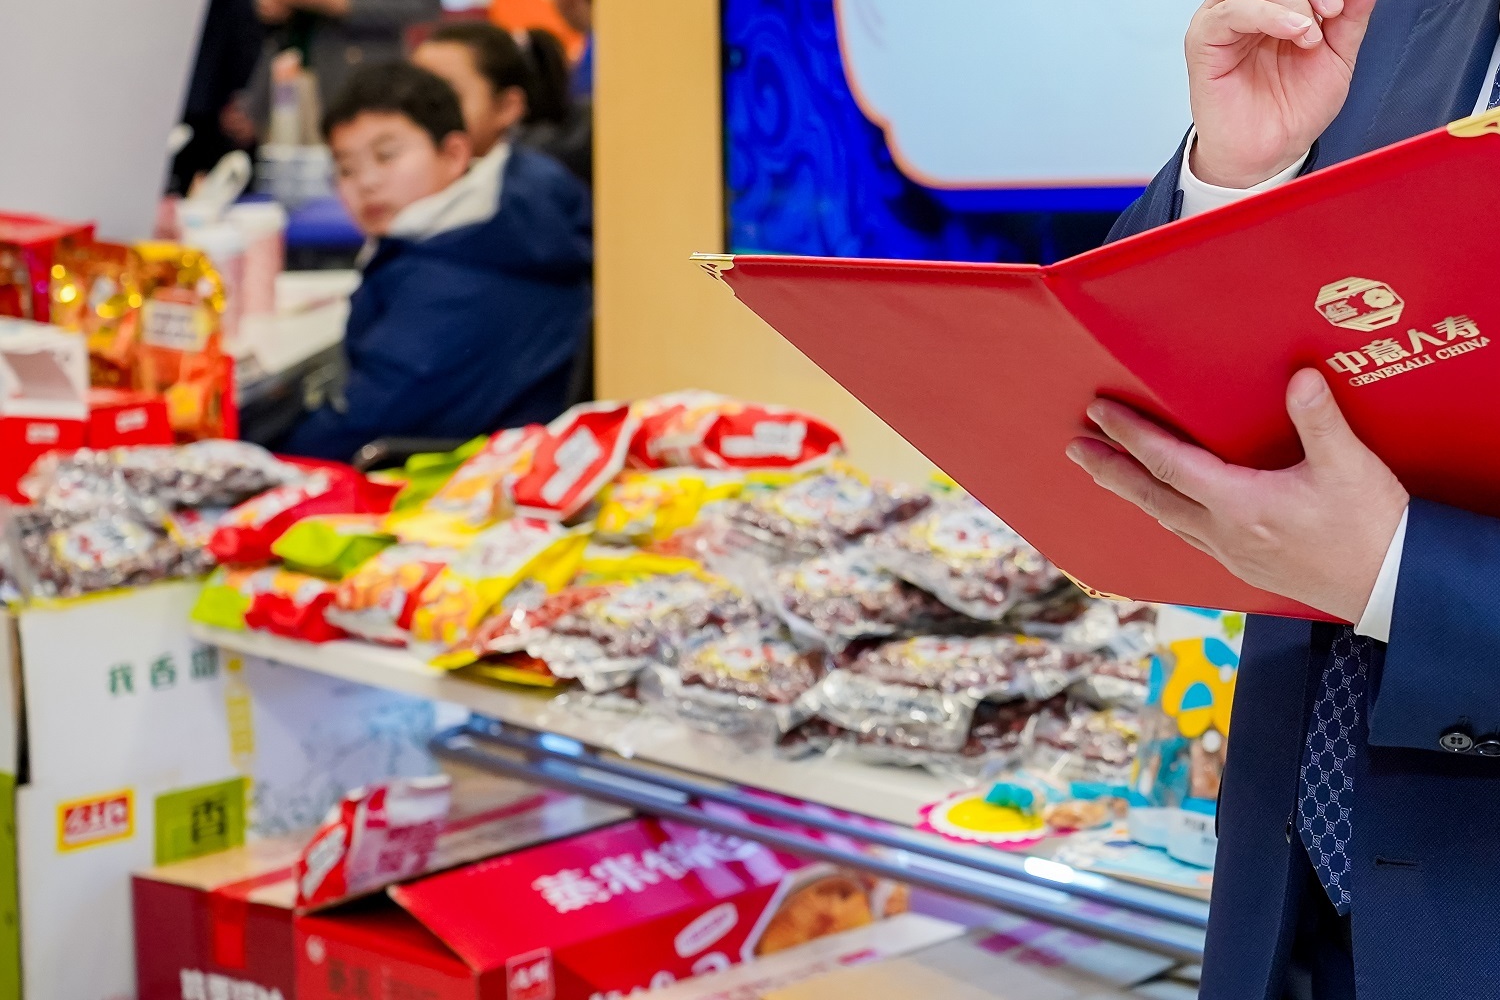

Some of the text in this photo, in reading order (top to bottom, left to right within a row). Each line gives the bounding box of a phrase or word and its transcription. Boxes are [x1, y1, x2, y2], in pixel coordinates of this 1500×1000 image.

[1325, 314, 1481, 375] 中意人寿
[1348, 336, 1491, 387] GENERALI CHINA
